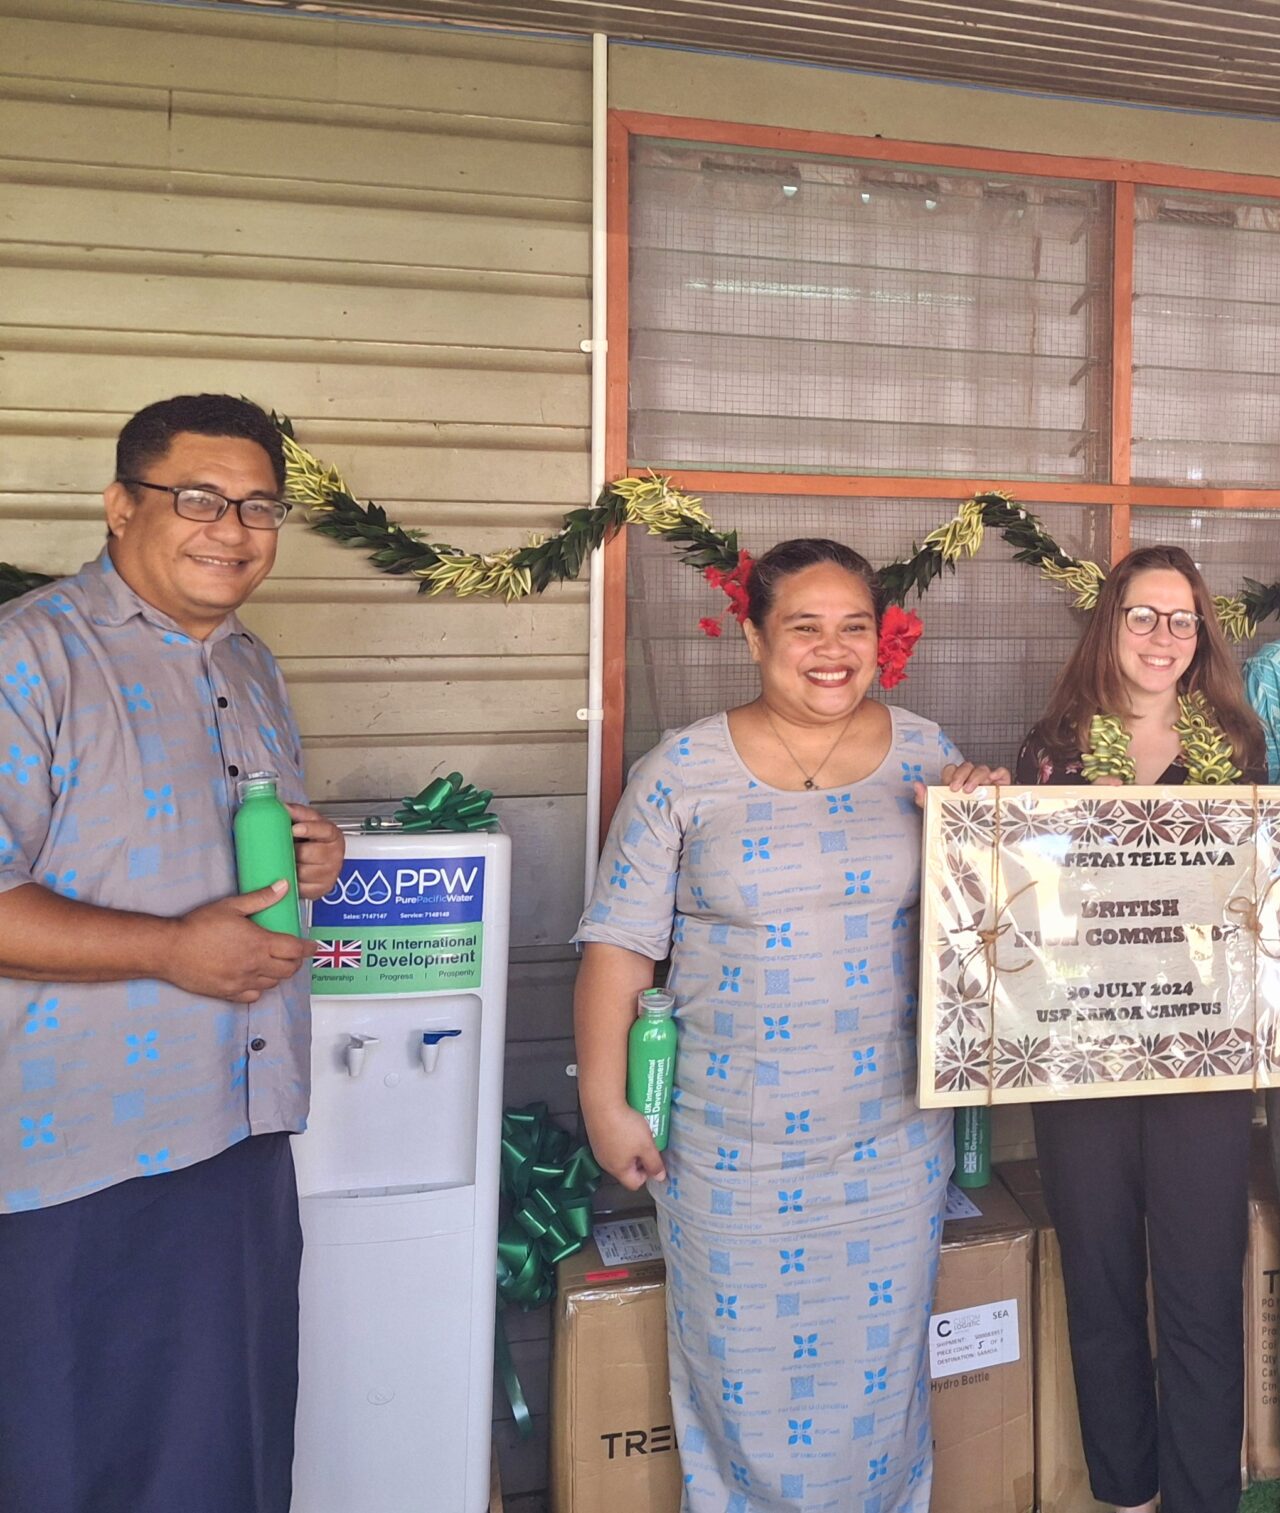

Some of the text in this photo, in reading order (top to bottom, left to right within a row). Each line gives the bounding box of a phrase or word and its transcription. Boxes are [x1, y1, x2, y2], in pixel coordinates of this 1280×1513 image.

[1128, 851, 1177, 867] TELE
[1180, 850, 1235, 867] LAVA
[395, 866, 478, 896] PPW
[395, 894, 474, 905] PurePacificWater
[1081, 899, 1180, 919] BRITISH
[367, 935, 477, 951] UK International
[366, 949, 476, 968] Development
[311, 974, 355, 982] Partnership
[379, 973, 414, 982] Progress
[1094, 982, 1147, 999] JULY
[1150, 981, 1194, 996] 2024
[1037, 1002, 1222, 1023] USP SAMOA CAMPUS
[652, 1058, 665, 1113] Development
[992, 1309, 1009, 1320] SEA
[930, 1371, 991, 1394] Hydro Bottle
[601, 1425, 678, 1459] TRE
